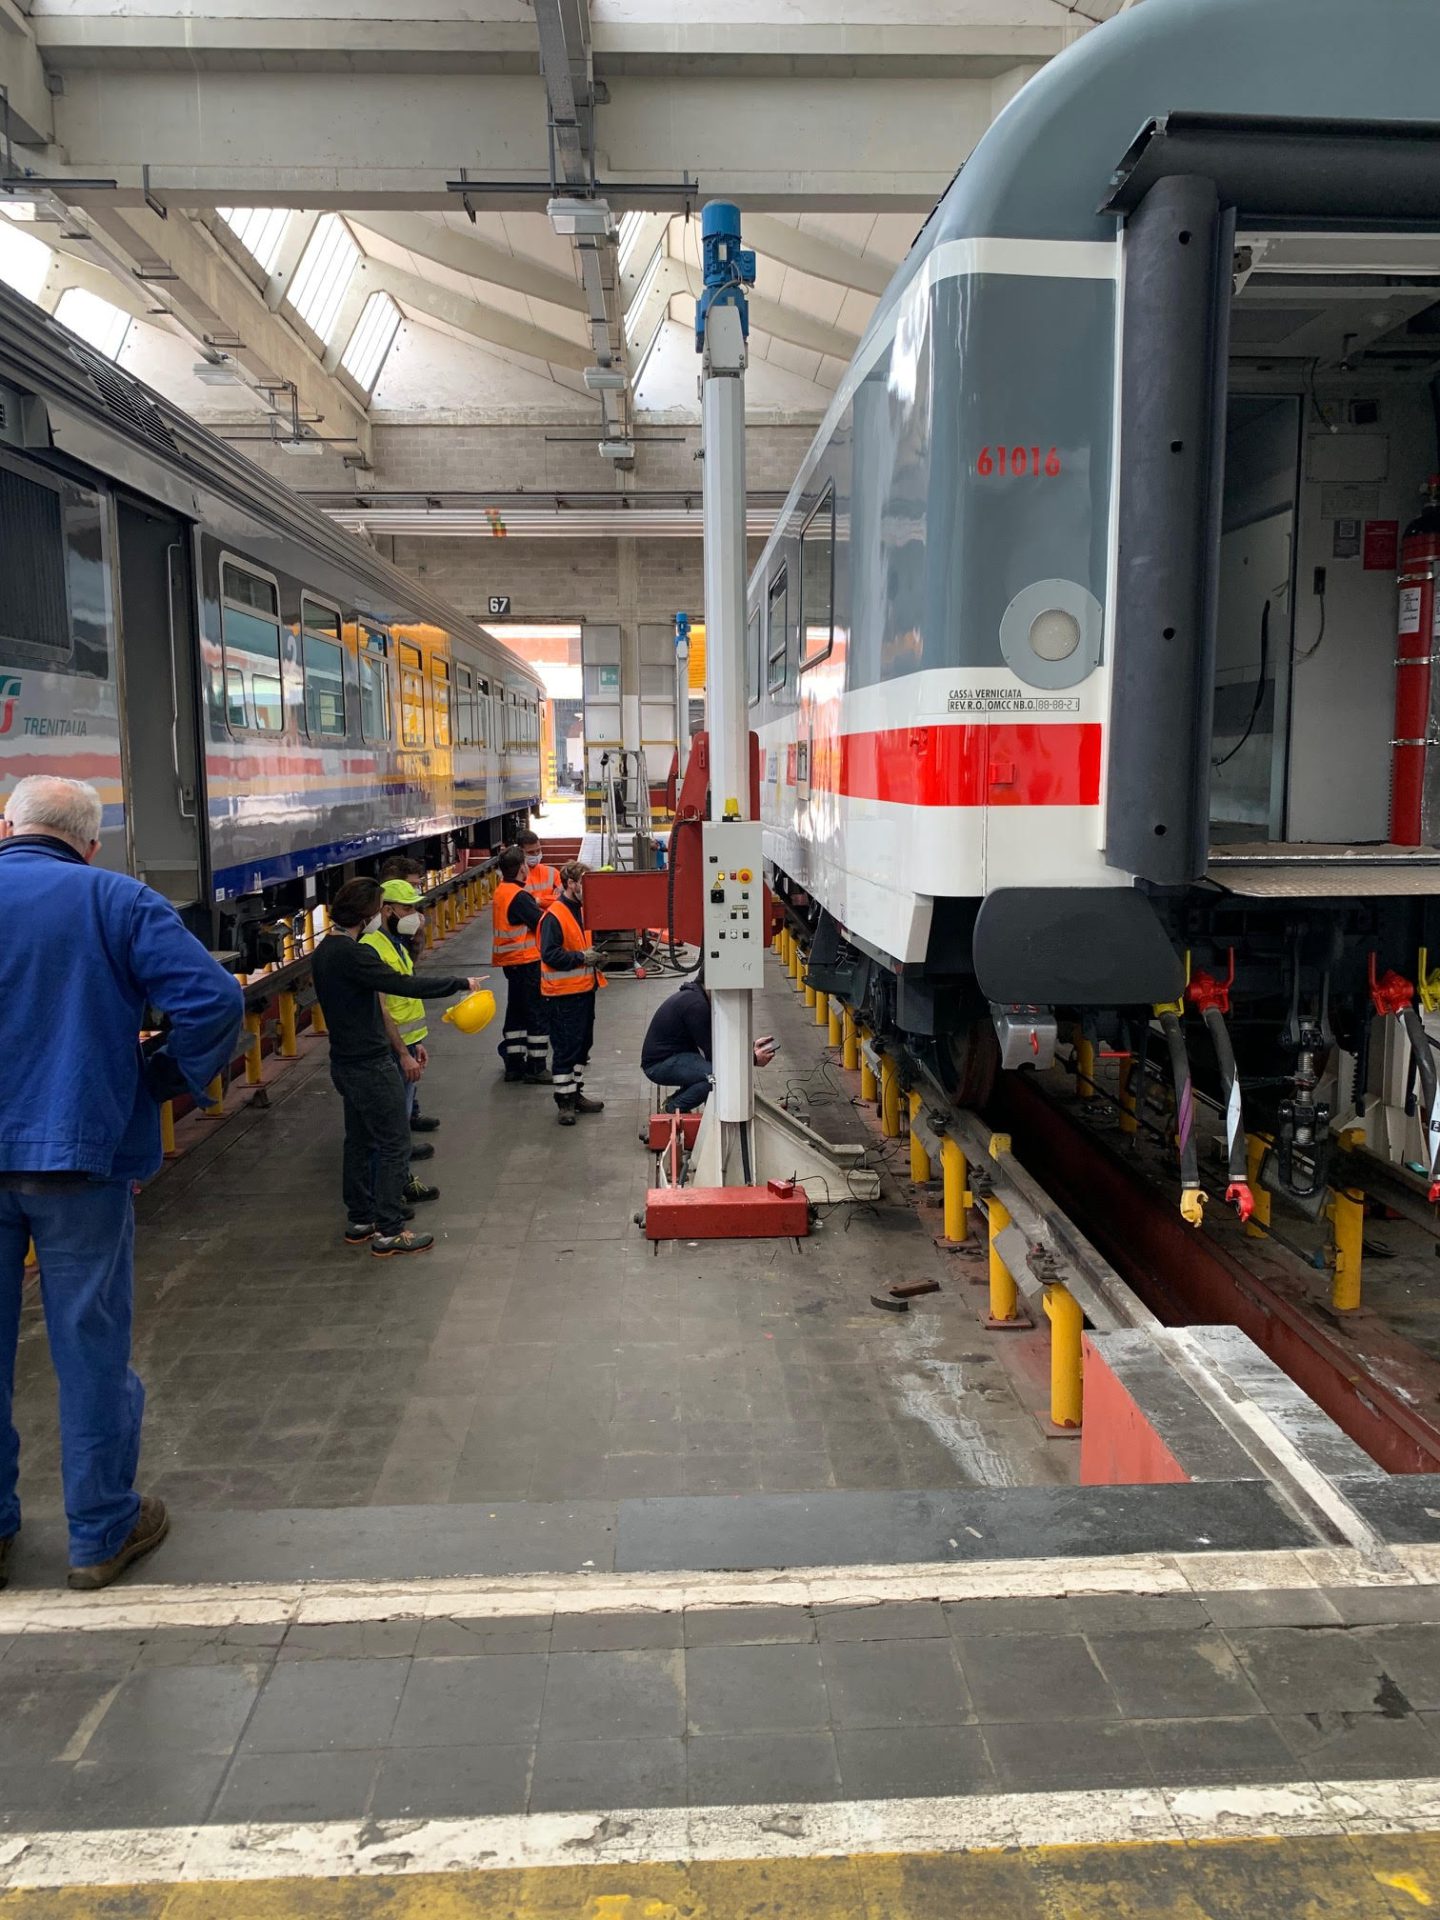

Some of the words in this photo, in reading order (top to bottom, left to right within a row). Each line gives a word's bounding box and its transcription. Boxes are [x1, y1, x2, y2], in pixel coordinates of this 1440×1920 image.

[977, 447, 1061, 477] 61016
[490, 598, 508, 612] 67
[949, 689, 973, 698] CASSA
[975, 689, 1022, 698] VERNICIATA
[987, 700, 1011, 710] OMCC
[23, 717, 87, 736] TRENITALIA
